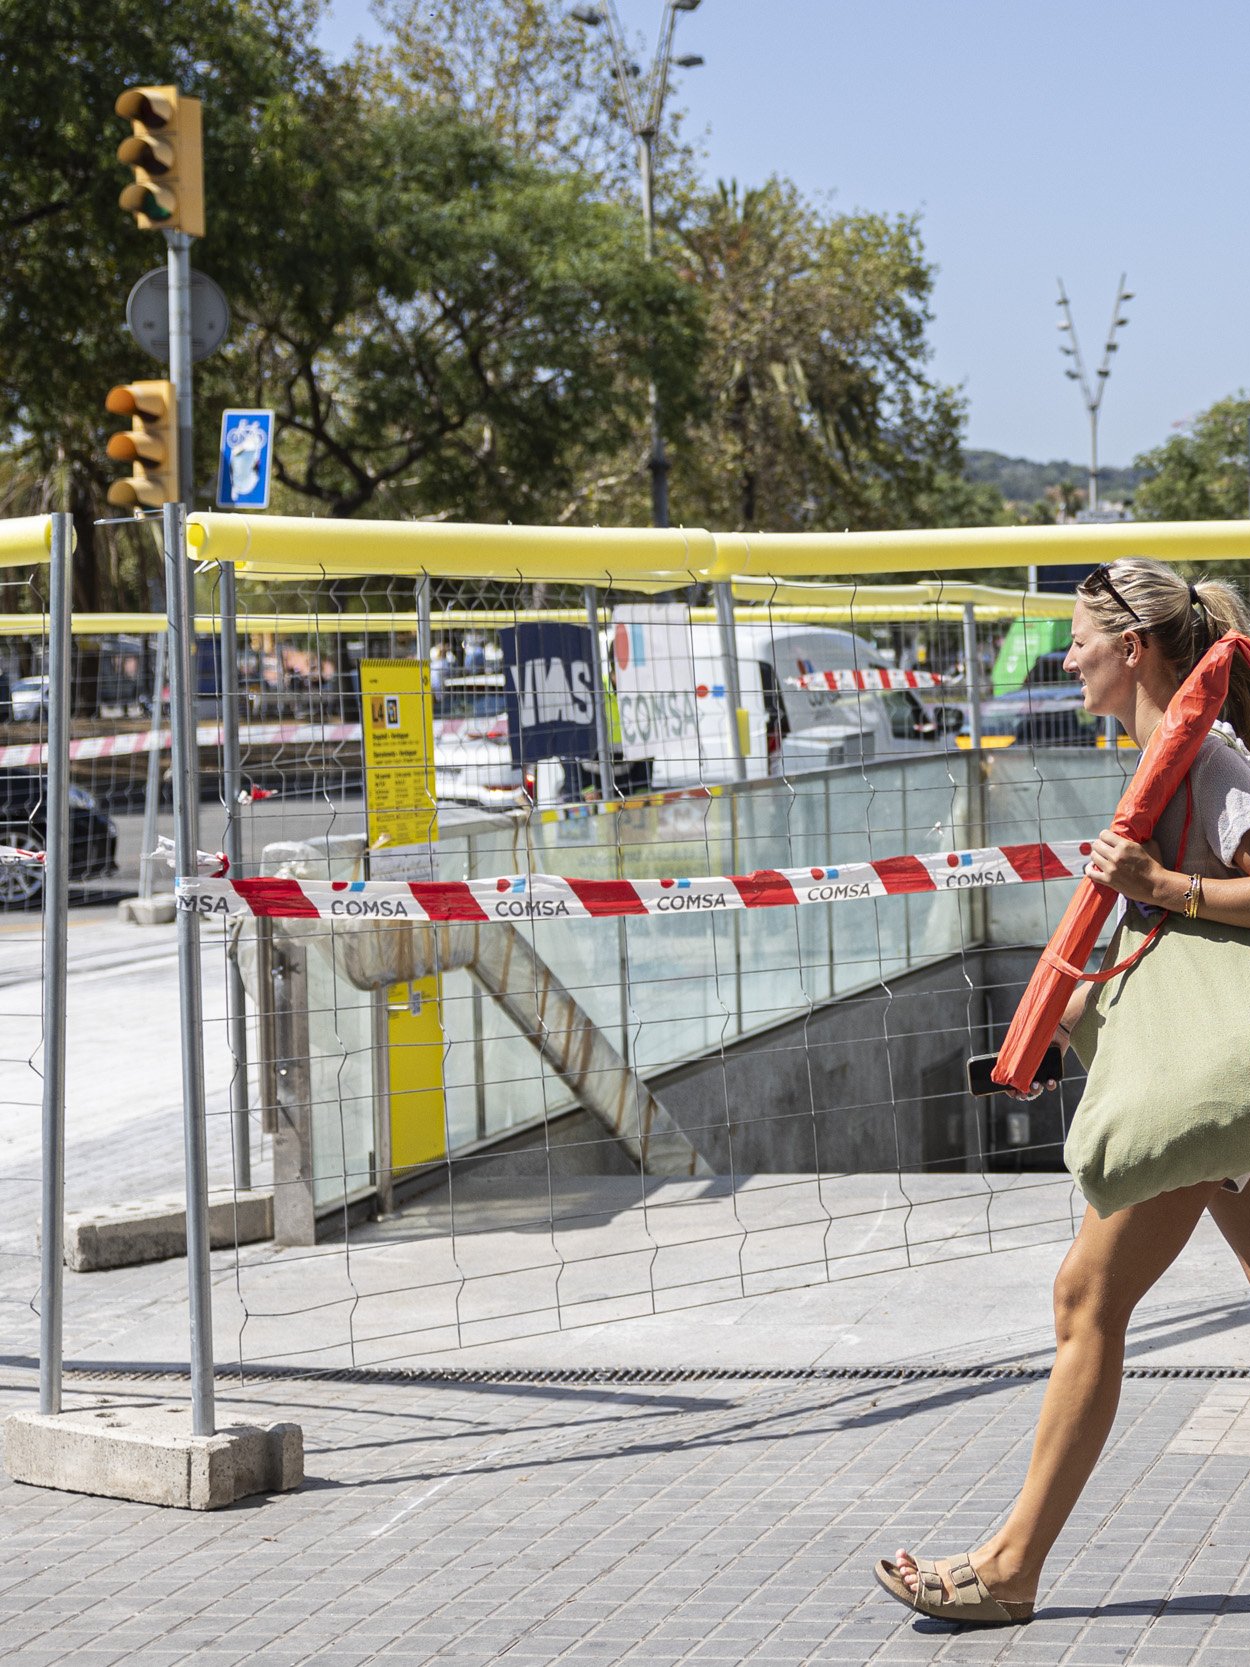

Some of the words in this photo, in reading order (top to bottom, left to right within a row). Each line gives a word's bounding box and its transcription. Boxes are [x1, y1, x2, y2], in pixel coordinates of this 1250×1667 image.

[620, 690, 698, 745] COMSA
[946, 870, 1006, 889] COMSA
[807, 883, 871, 901] COMSA
[331, 899, 408, 918] COMSA
[495, 900, 570, 917] COMSA
[656, 893, 727, 911] COMSA
